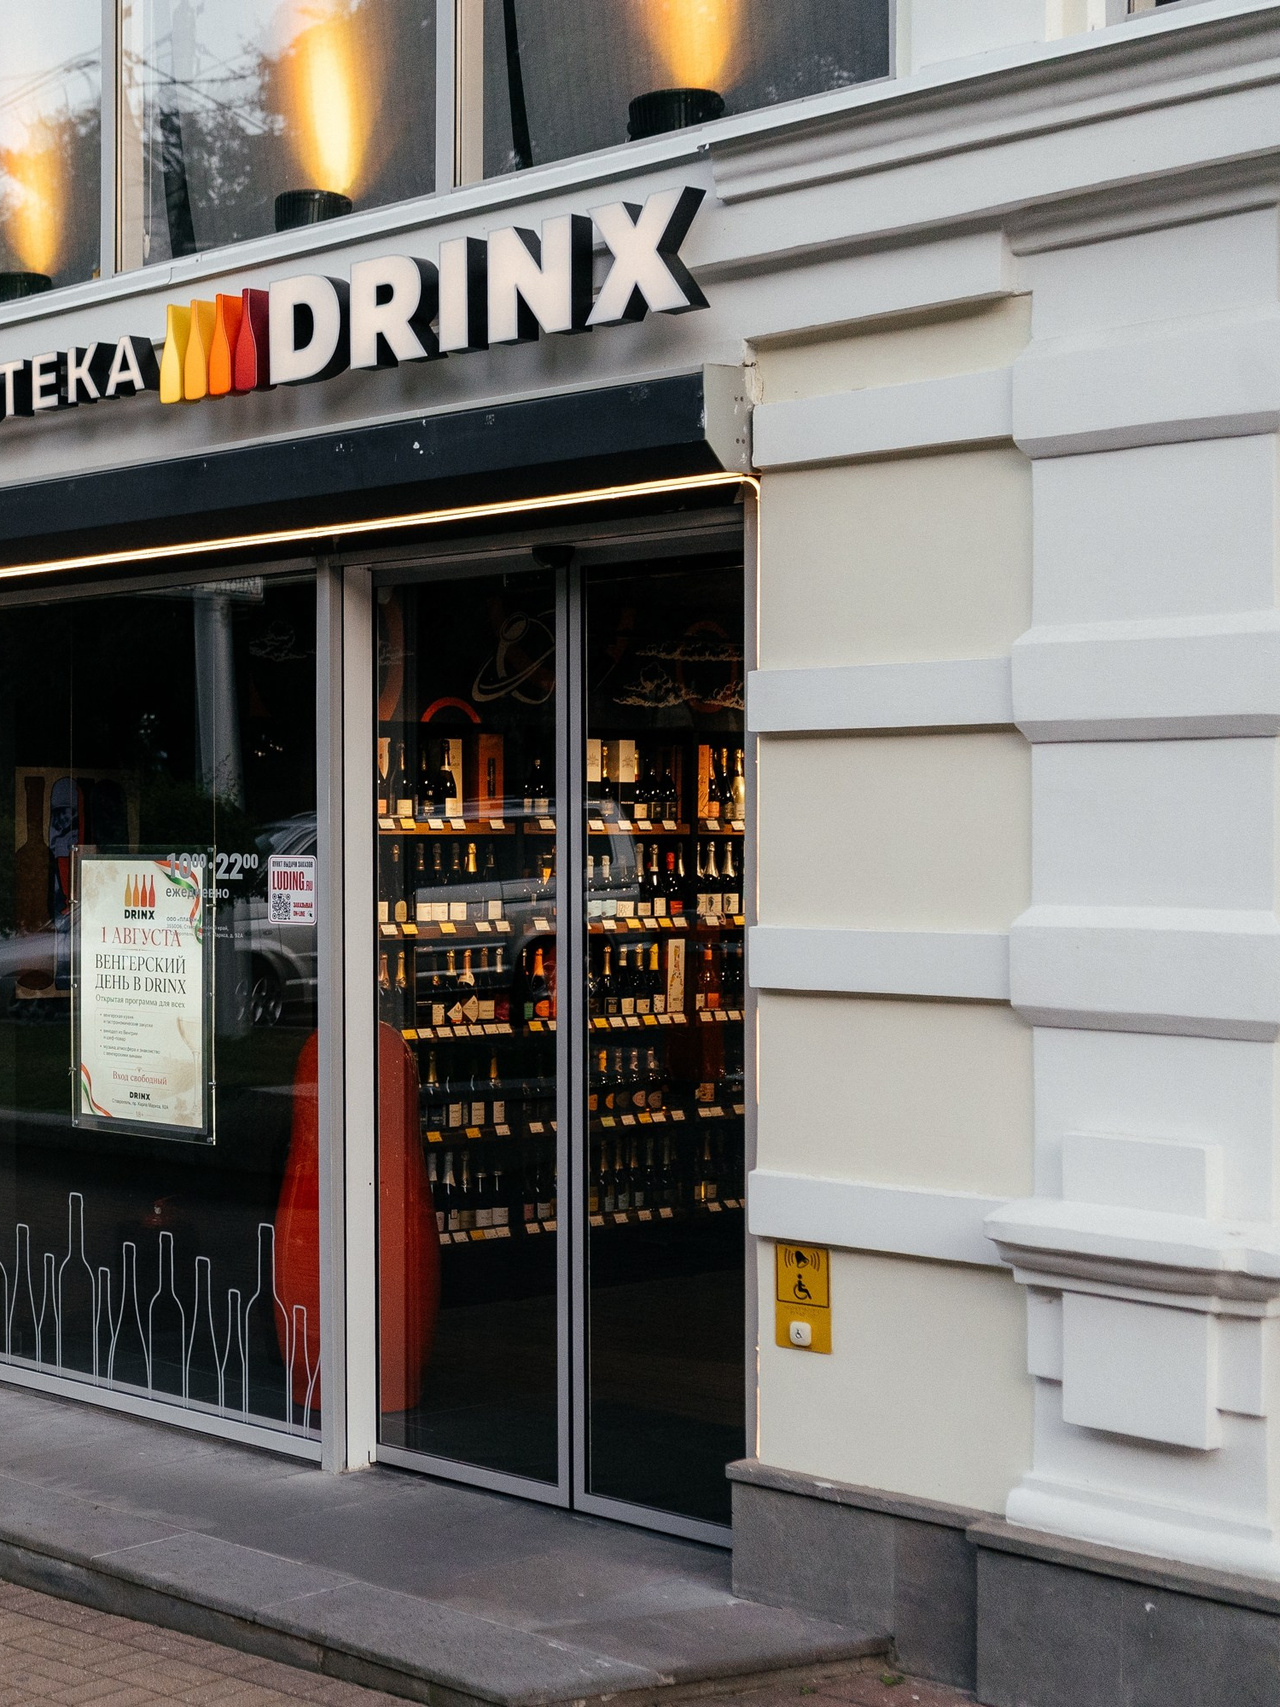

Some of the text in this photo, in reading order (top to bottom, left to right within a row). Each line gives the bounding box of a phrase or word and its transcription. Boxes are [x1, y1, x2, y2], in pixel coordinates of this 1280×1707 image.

[269, 186, 702, 386] DRINX
[124, 909, 155, 920] DRINX
[101, 926, 106, 943] 1
[112, 926, 182, 948] АВГУСТА
[95, 954, 186, 974] ВЕНГЕРСКИЙ
[94, 974, 186, 994] ДЕНЬ В DRINX
[95, 994, 124, 1004] Открытая
[124, 997, 158, 1006] программа
[112, 1070, 168, 1085] Вход свободный
[130, 1091, 150, 1100] DRINX
